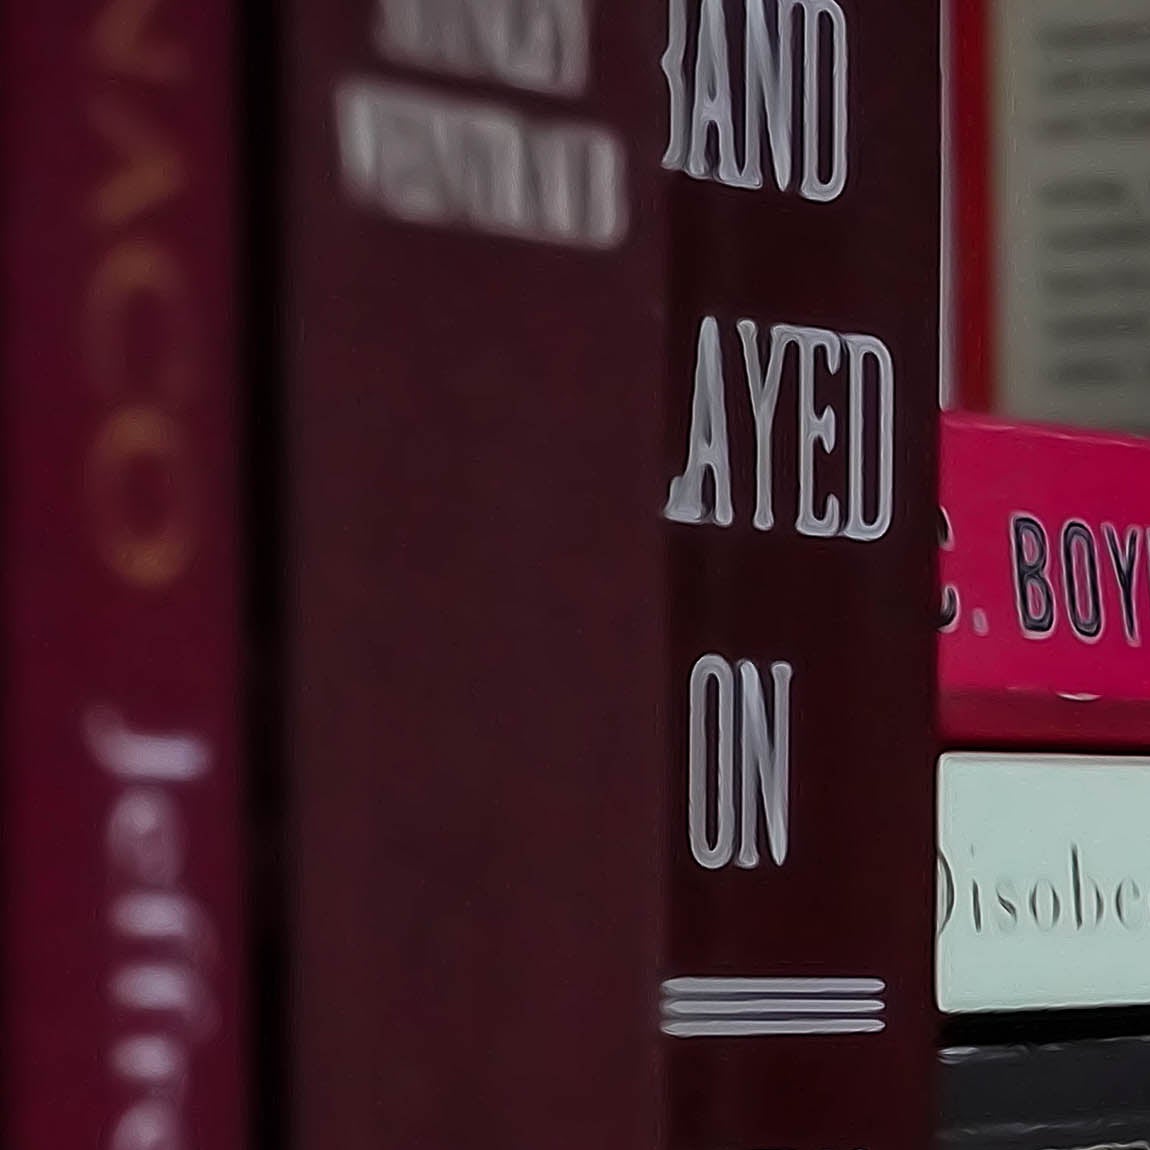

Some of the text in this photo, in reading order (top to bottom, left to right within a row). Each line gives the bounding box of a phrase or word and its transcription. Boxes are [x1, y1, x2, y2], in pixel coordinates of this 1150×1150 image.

[660, 0, 848, 202] AND
[662, 315, 894, 542] AYED
[687, 653, 793, 870] ON
